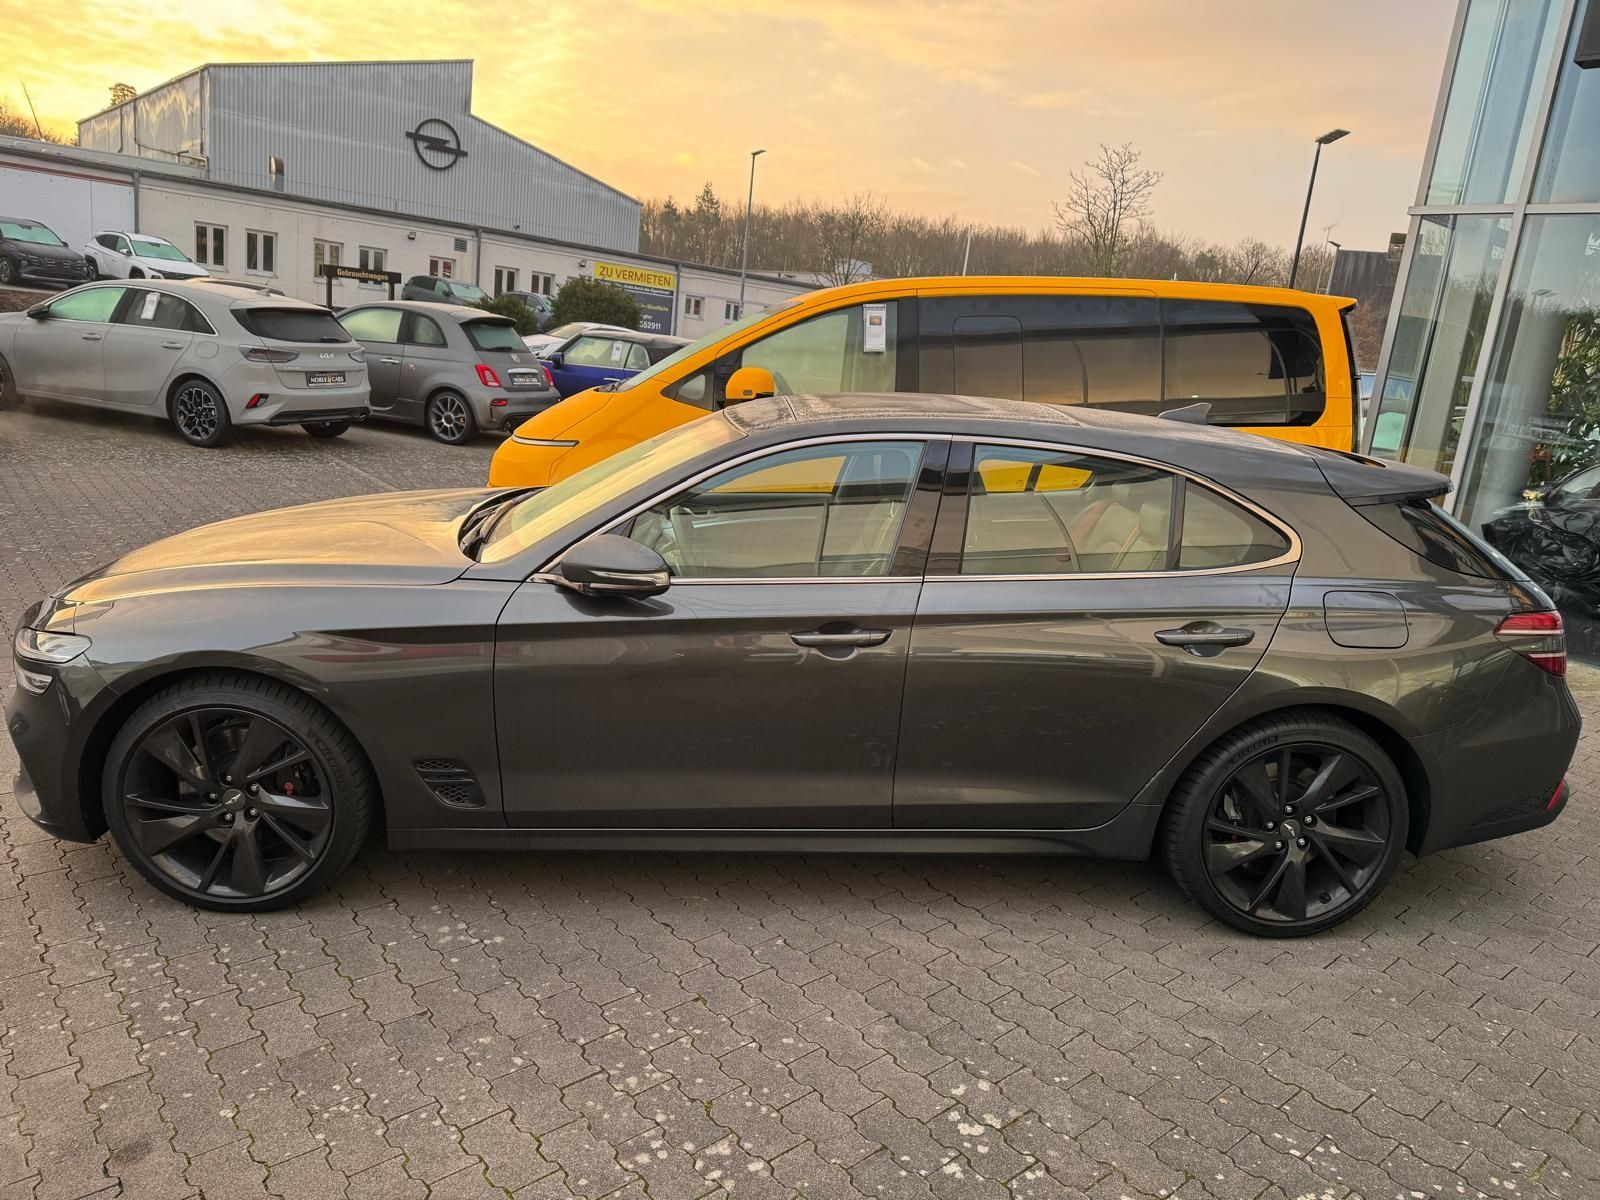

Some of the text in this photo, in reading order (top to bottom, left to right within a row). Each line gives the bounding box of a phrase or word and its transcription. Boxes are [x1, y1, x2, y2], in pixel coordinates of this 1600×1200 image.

[336, 268, 389, 281] Gebrauchtwagen
[599, 265, 671, 287] ZU VERMIETEN
